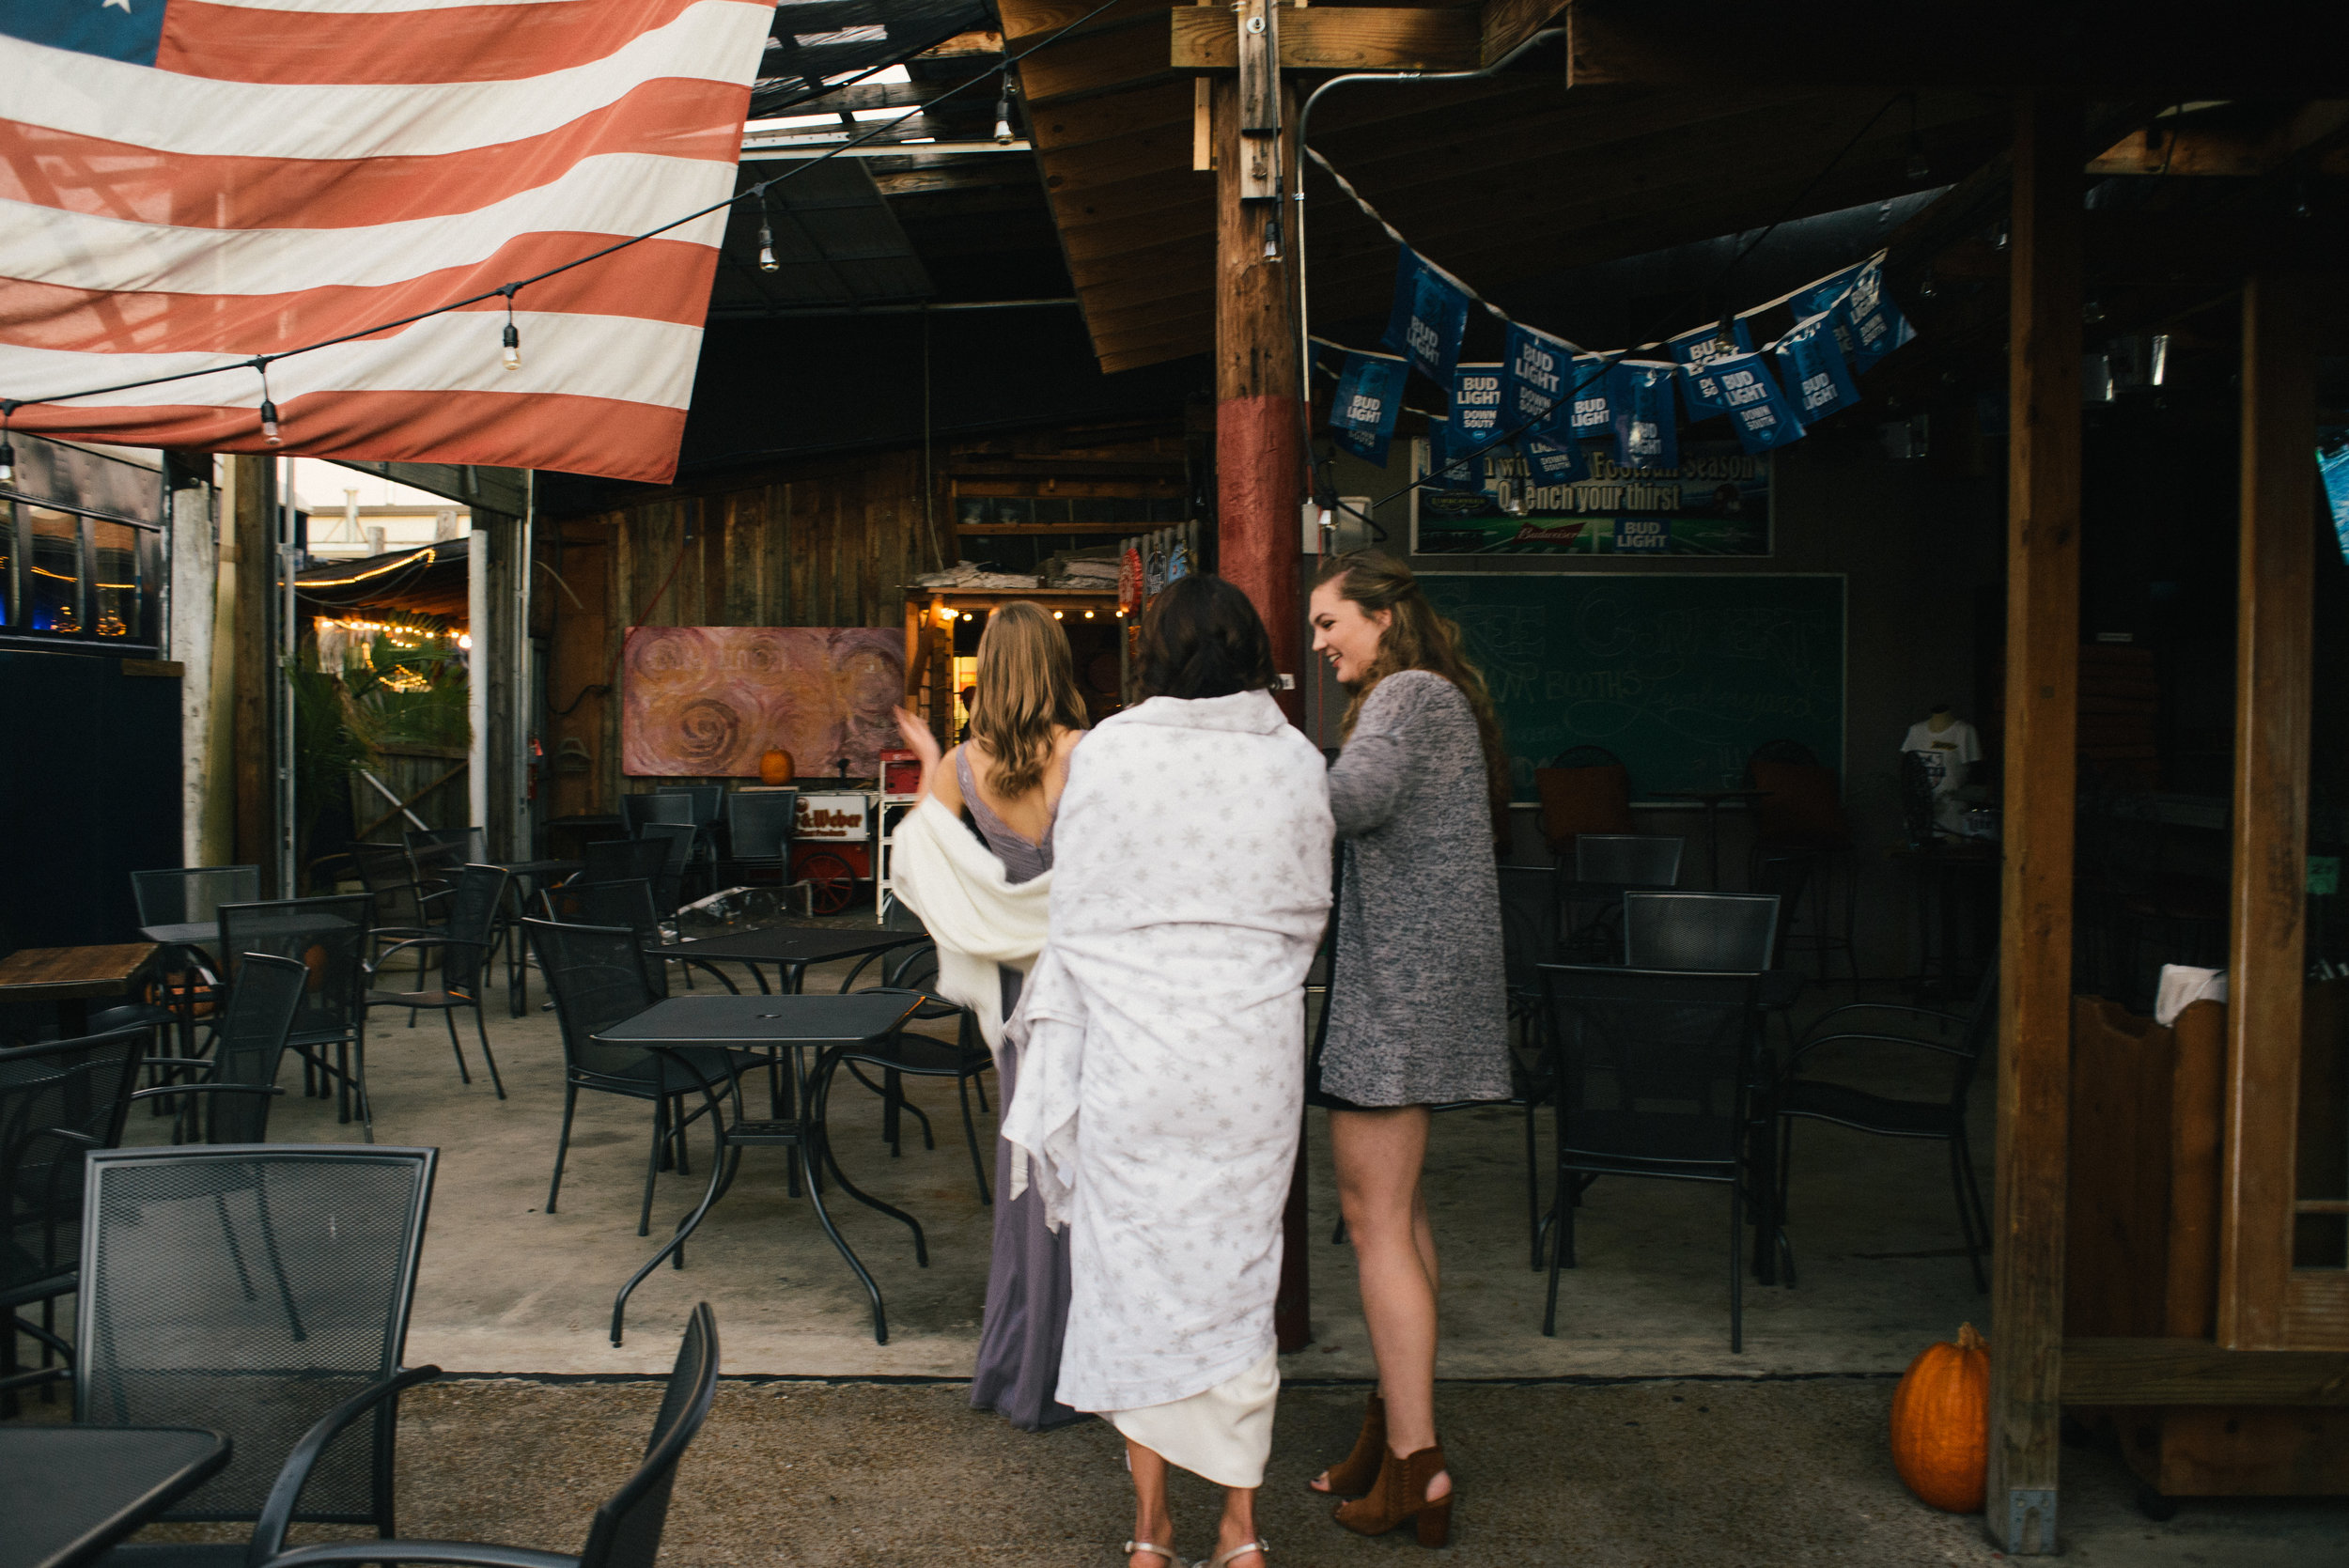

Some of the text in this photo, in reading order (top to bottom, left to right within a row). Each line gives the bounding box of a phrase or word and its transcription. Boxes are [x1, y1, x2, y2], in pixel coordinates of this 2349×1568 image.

[1410, 315, 1439, 349] BUD
[1406, 327, 1440, 366] LIGHT
[1522, 342, 1555, 373] BUD
[1463, 377, 1500, 391] BUD
[1514, 357, 1561, 393] LIGHT
[1721, 370, 1755, 391] BUD
[1801, 372, 1831, 396] BUD
[1353, 395, 1382, 411] BUD
[1457, 391, 1501, 406] LIGHT
[1725, 382, 1768, 407] LIGHT
[1803, 383, 1839, 411] LIGHT
[1346, 406, 1383, 425] LIGHT
[1463, 410, 1499, 420] DOWN
[1574, 397, 1608, 414] BUD
[1571, 410, 1610, 427] LIGHT
[1498, 480, 1575, 511] Qench
[1576, 486, 1625, 514] your
[1626, 482, 1681, 511] thirst
[1624, 520, 1662, 535] BUD
[1616, 534, 1671, 548] LIGHT
[1545, 668, 1642, 701] BOOTHS
